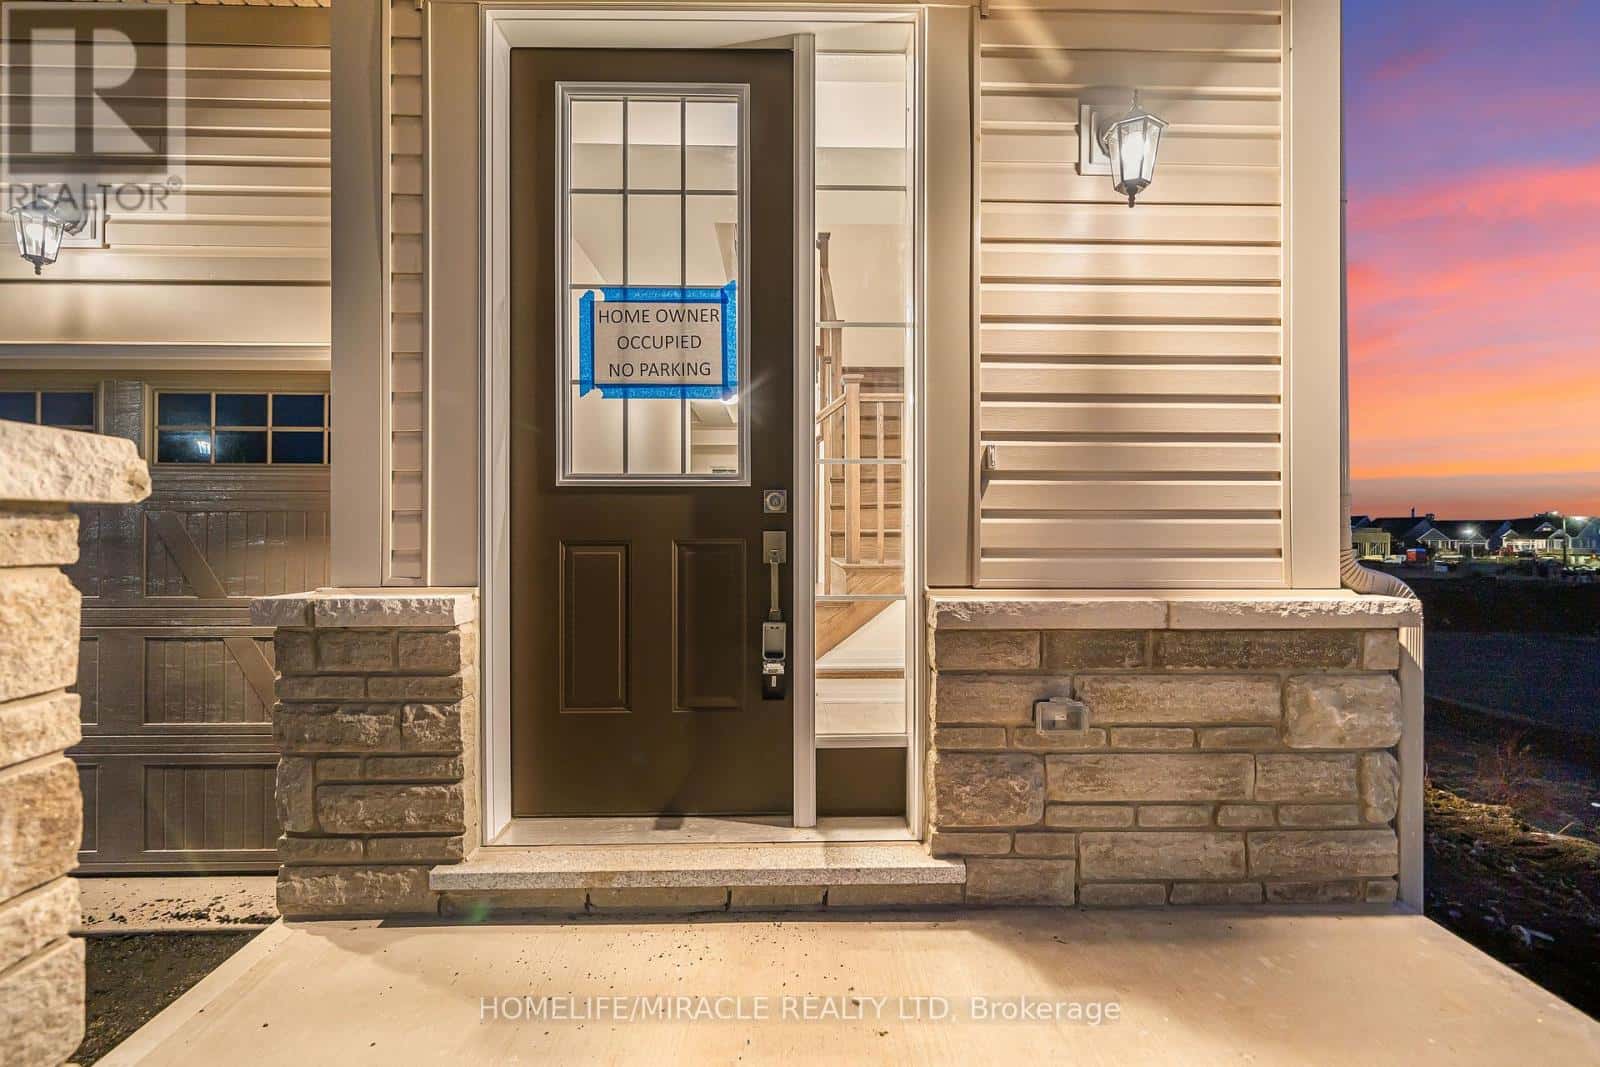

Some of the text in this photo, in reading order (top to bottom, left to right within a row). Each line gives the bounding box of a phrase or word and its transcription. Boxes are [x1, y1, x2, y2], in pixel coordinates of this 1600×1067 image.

[598, 308, 720, 324] HOME OWNER
[616, 335, 702, 350] OCCUPIED
[609, 362, 711, 378] NO PARKING
